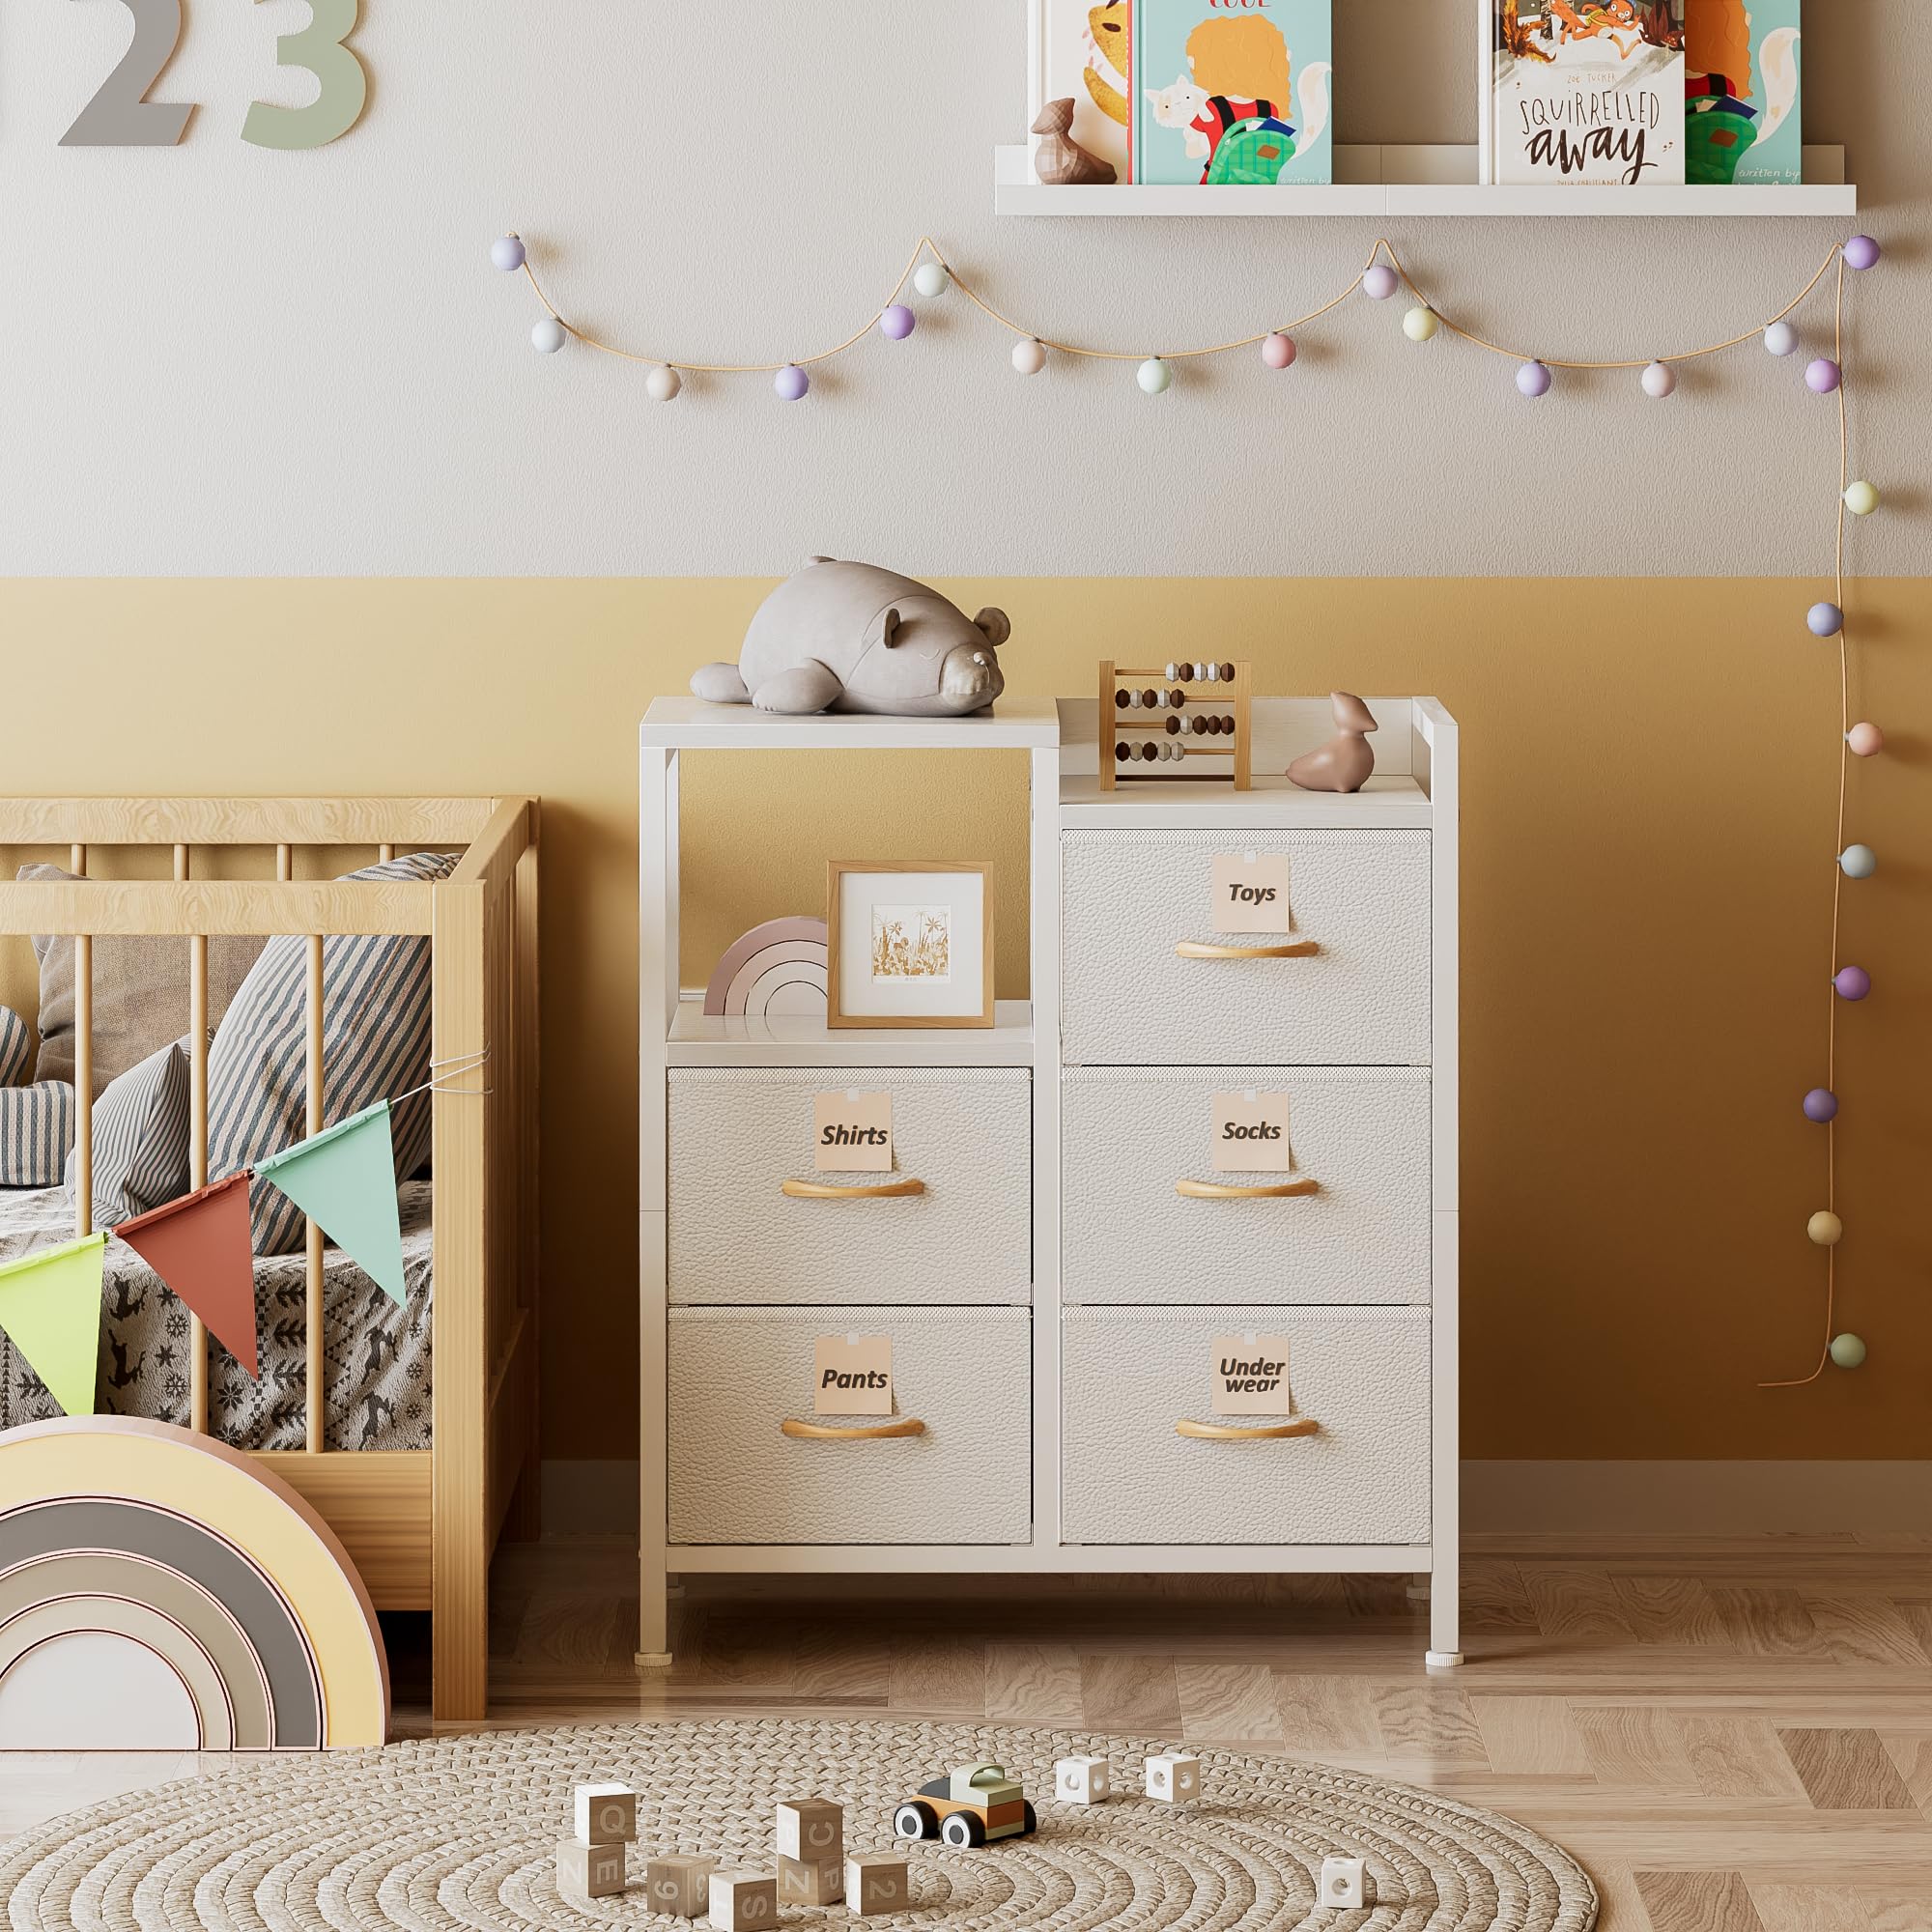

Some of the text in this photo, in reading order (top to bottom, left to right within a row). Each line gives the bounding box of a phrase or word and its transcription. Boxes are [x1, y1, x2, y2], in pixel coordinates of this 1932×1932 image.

[1525, 127, 1659, 185] away
[1785, 168, 1801, 184] by
[1229, 883, 1276, 906] Toys
[820, 1123, 888, 1146] Shirts
[1222, 1121, 1282, 1140] Socks
[1220, 1356, 1287, 1377] Under
[821, 1369, 888, 1389] Pants
[1225, 1378, 1280, 1393] wear
[599, 1804, 626, 1835] Q
